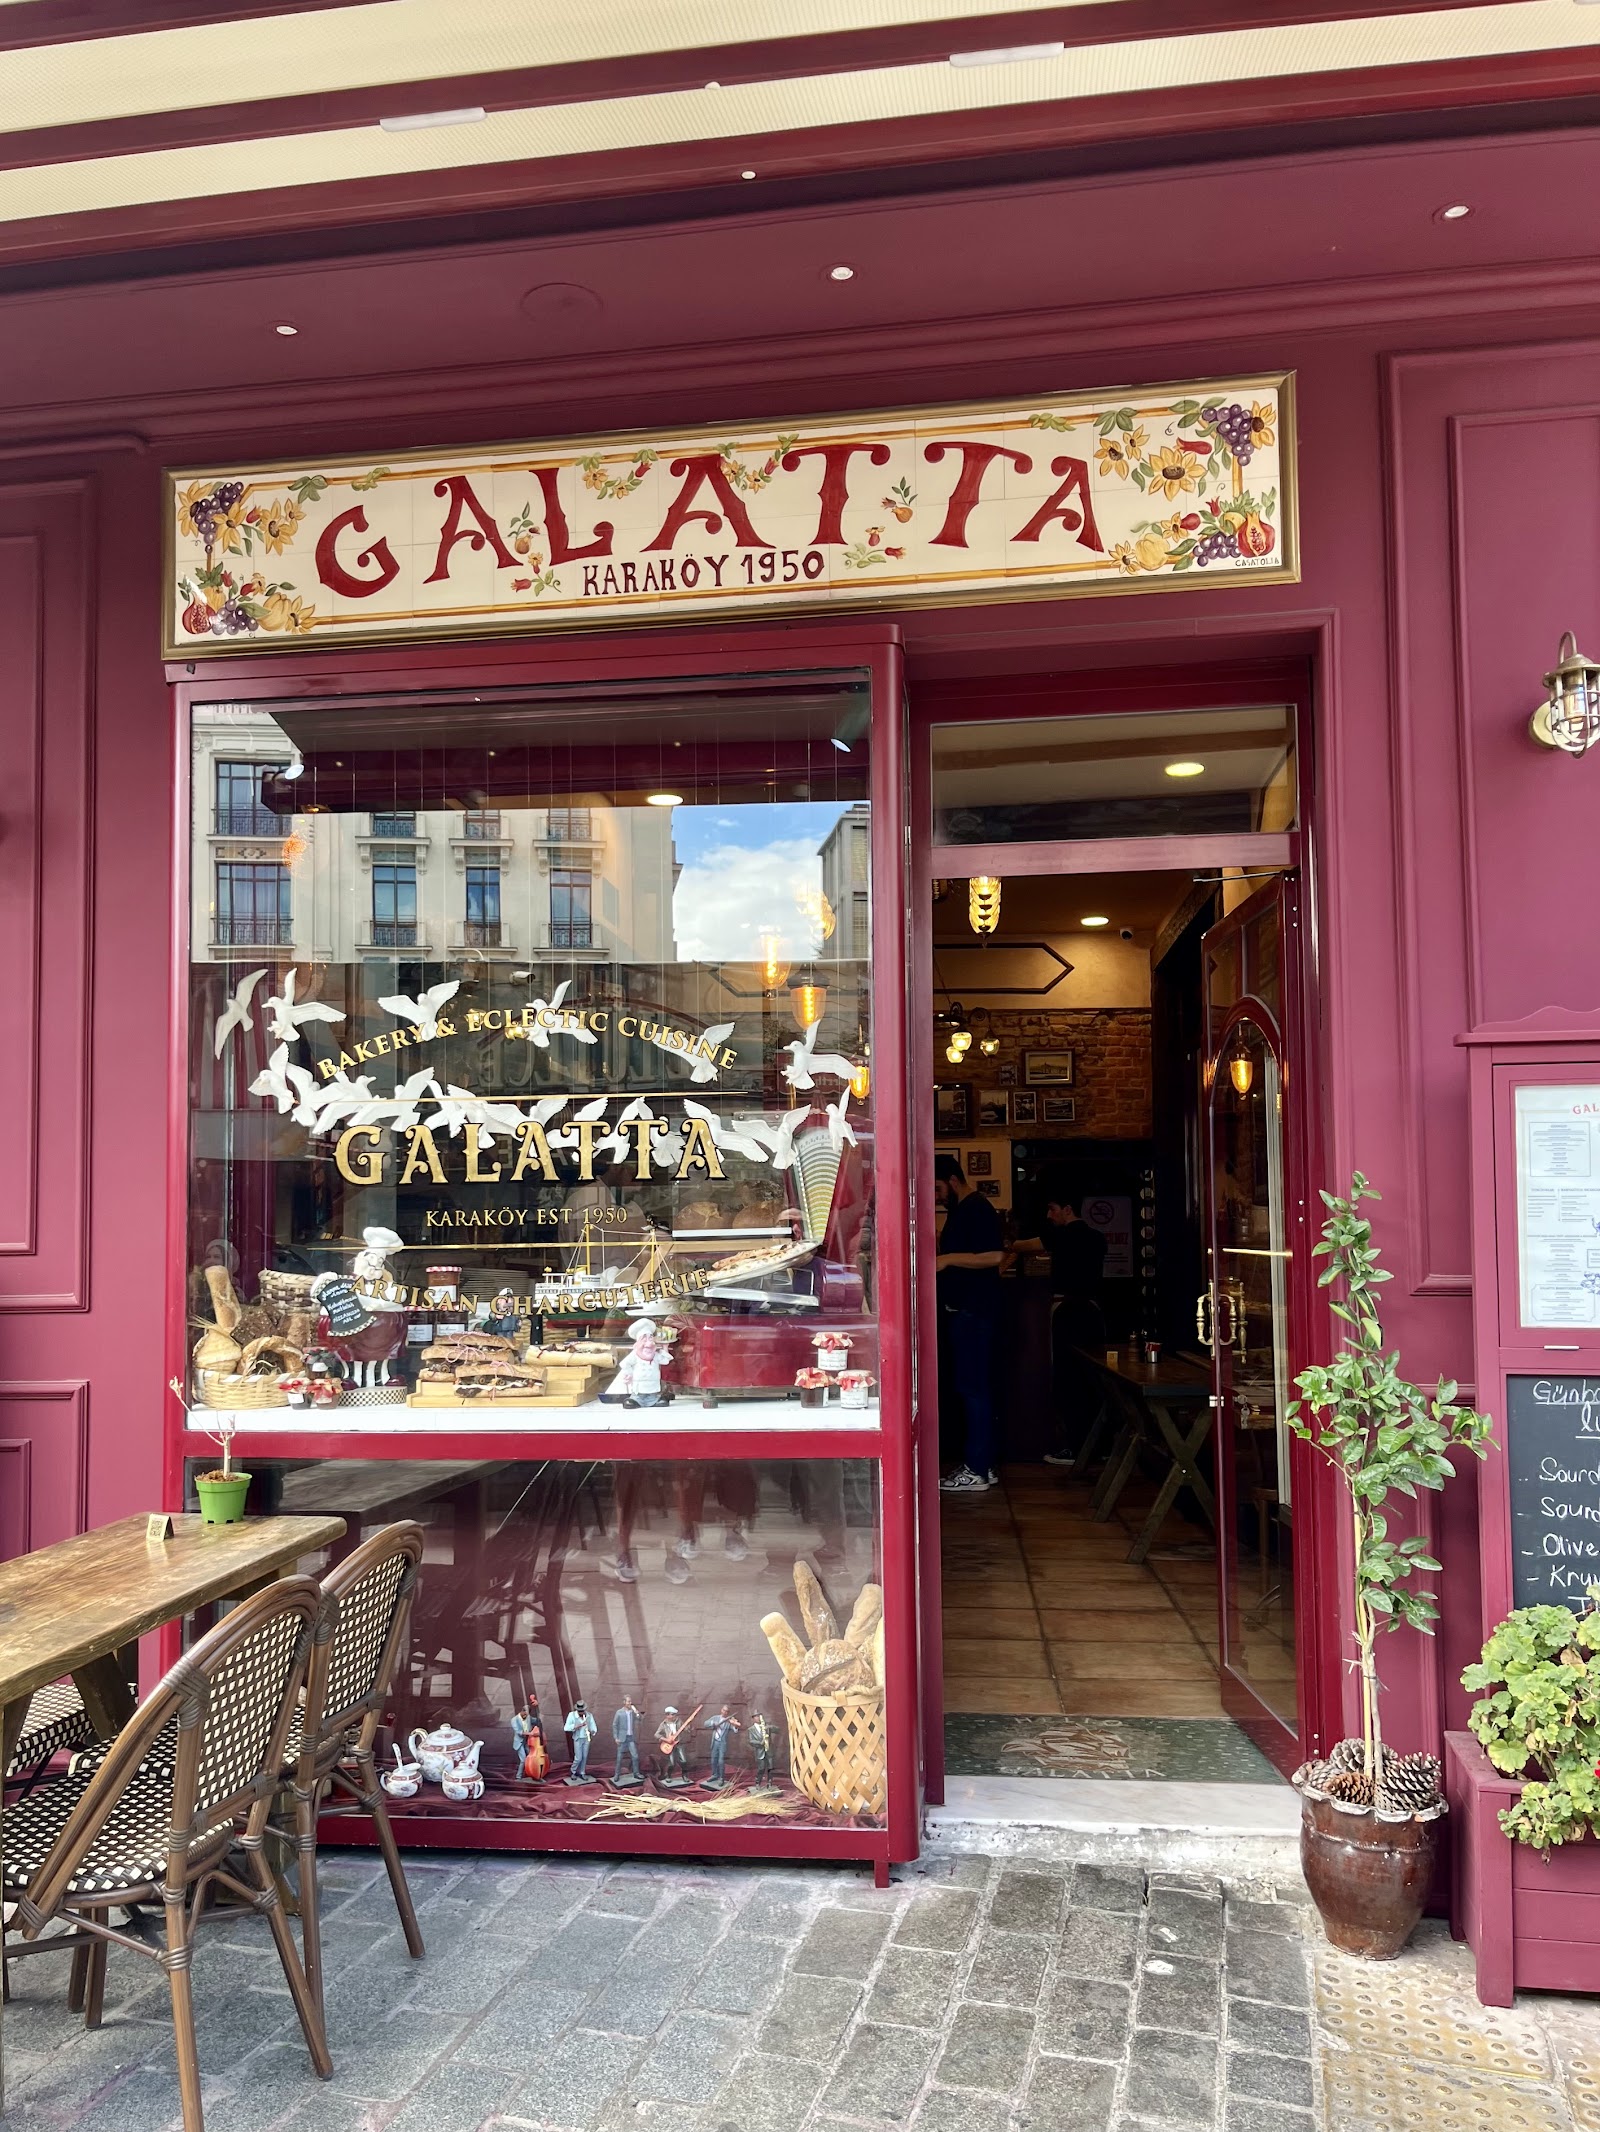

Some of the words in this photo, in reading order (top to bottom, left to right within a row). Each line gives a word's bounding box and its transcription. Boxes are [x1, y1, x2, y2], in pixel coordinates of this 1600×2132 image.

[315, 442, 1104, 598] GALATTA
[583, 554, 729, 597] KARAKÖY
[741, 550, 825, 585] 1950
[317, 1022, 427, 1080] BAKERY
[435, 1017, 458, 1038] &
[467, 1008, 609, 1032] ECLECTIC
[618, 1016, 738, 1070] CUISINE
[332, 1118, 728, 1185] GALATTA
[426, 1207, 528, 1227] KARAKÖY
[537, 1208, 573, 1226] EST
[582, 1206, 628, 1226] 1950
[350, 1274, 479, 1314] ARTISAN
[490, 1267, 711, 1316] CHARCUTERIE
[1543, 1533, 1600, 1556] Olive
